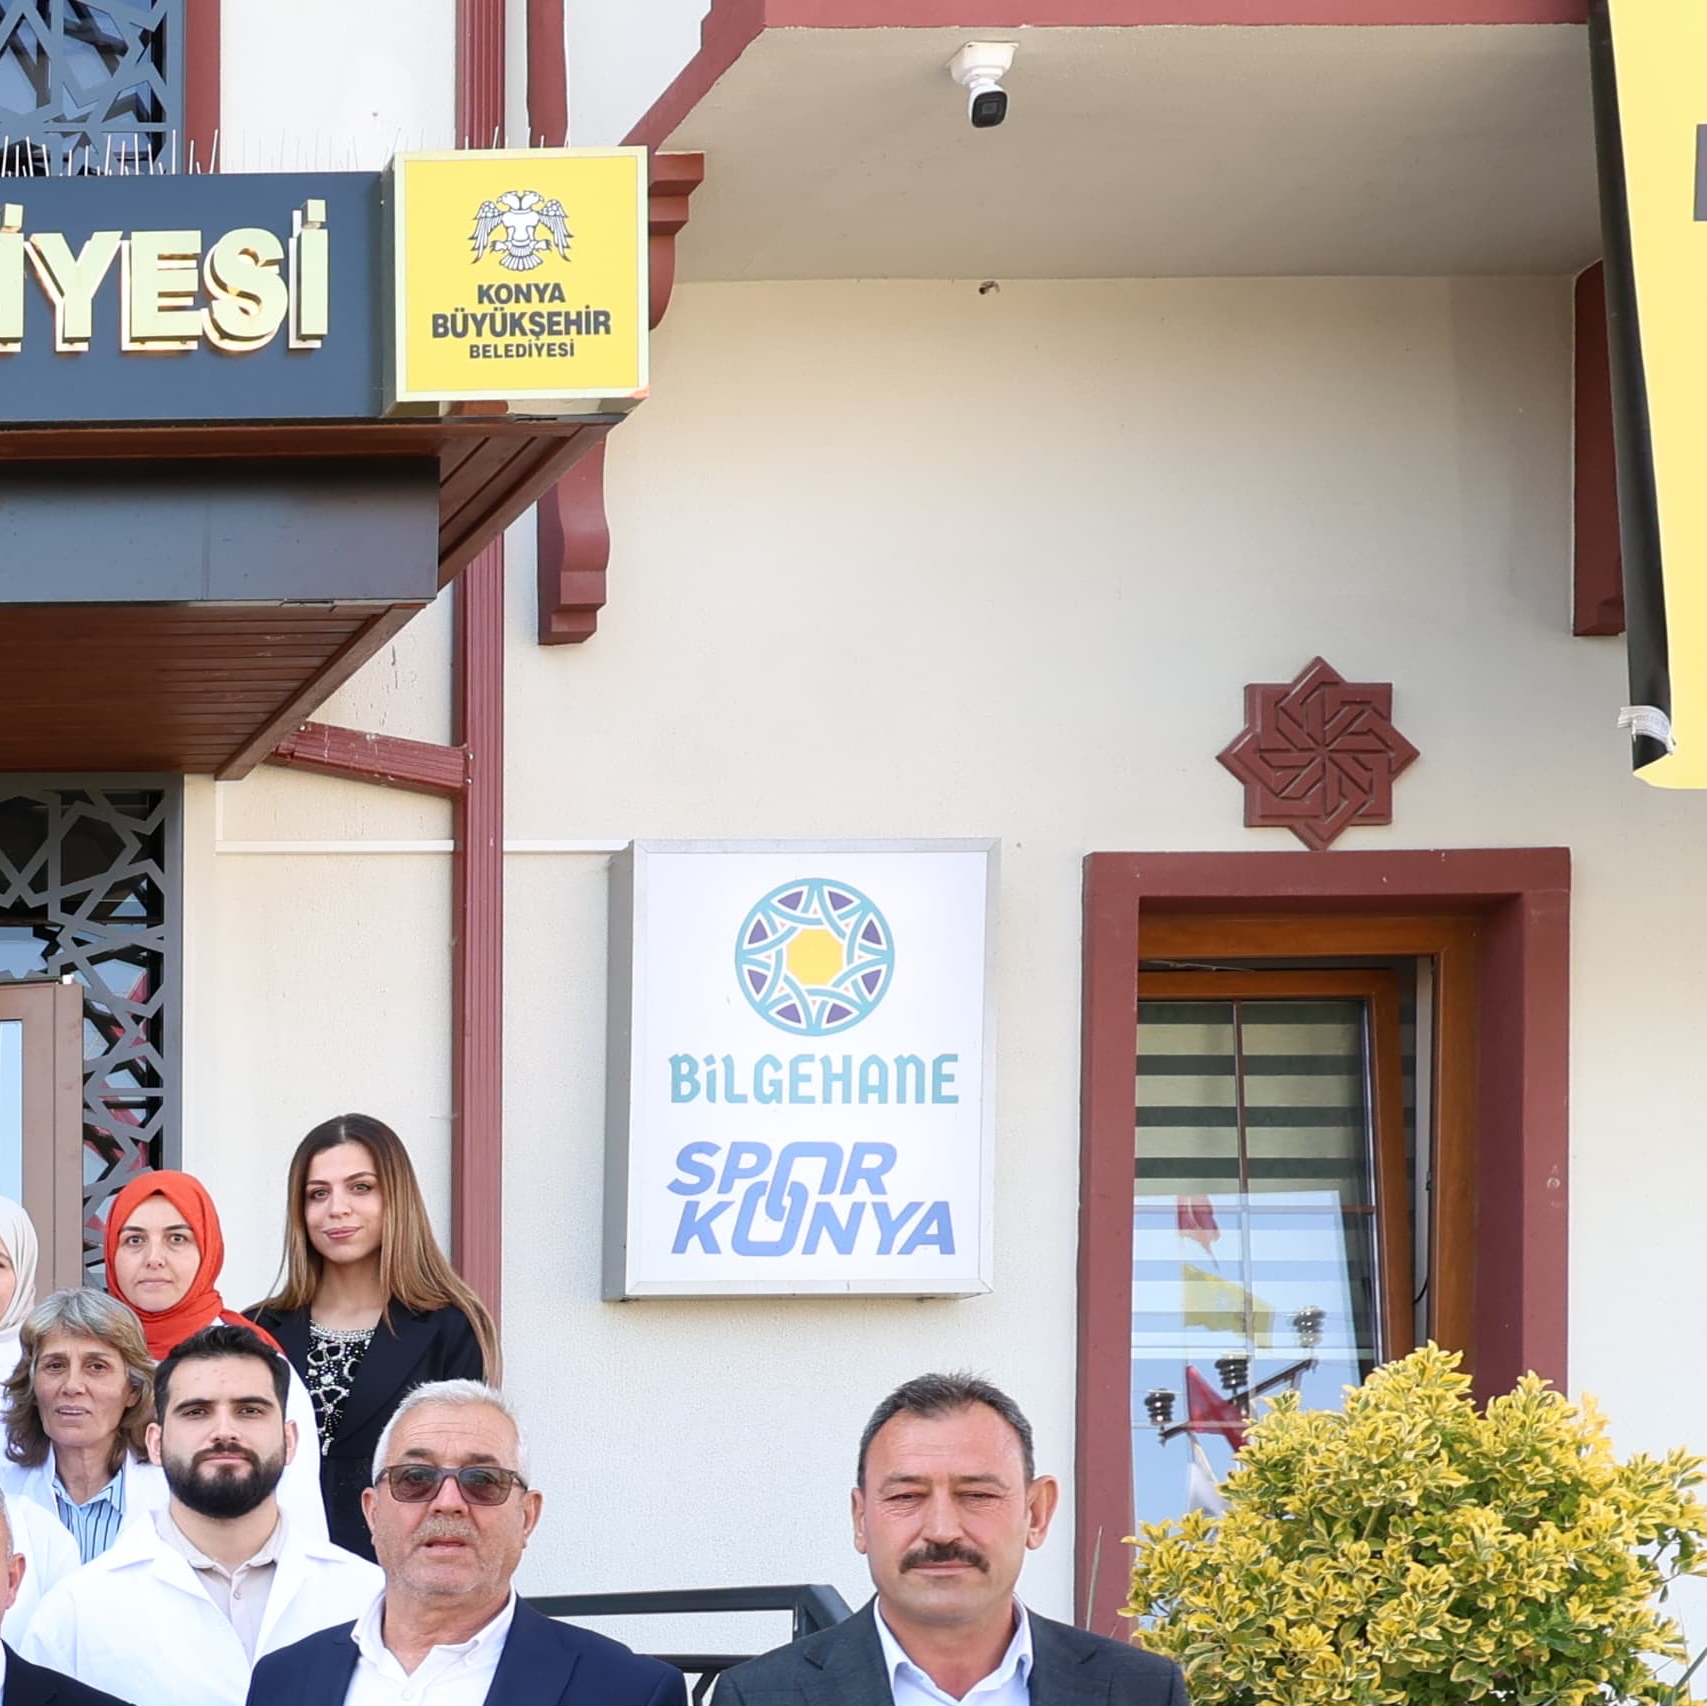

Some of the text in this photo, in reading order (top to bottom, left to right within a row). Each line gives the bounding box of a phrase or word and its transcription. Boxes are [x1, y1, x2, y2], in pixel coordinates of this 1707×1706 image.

[477, 282, 567, 305] KONYA
[431, 304, 612, 341] BÜYÜKŞEHİR
[469, 339, 575, 359] BELEDİYESİ
[666, 1141, 898, 1221] SPOR
[671, 1180, 956, 1257] KONYA
